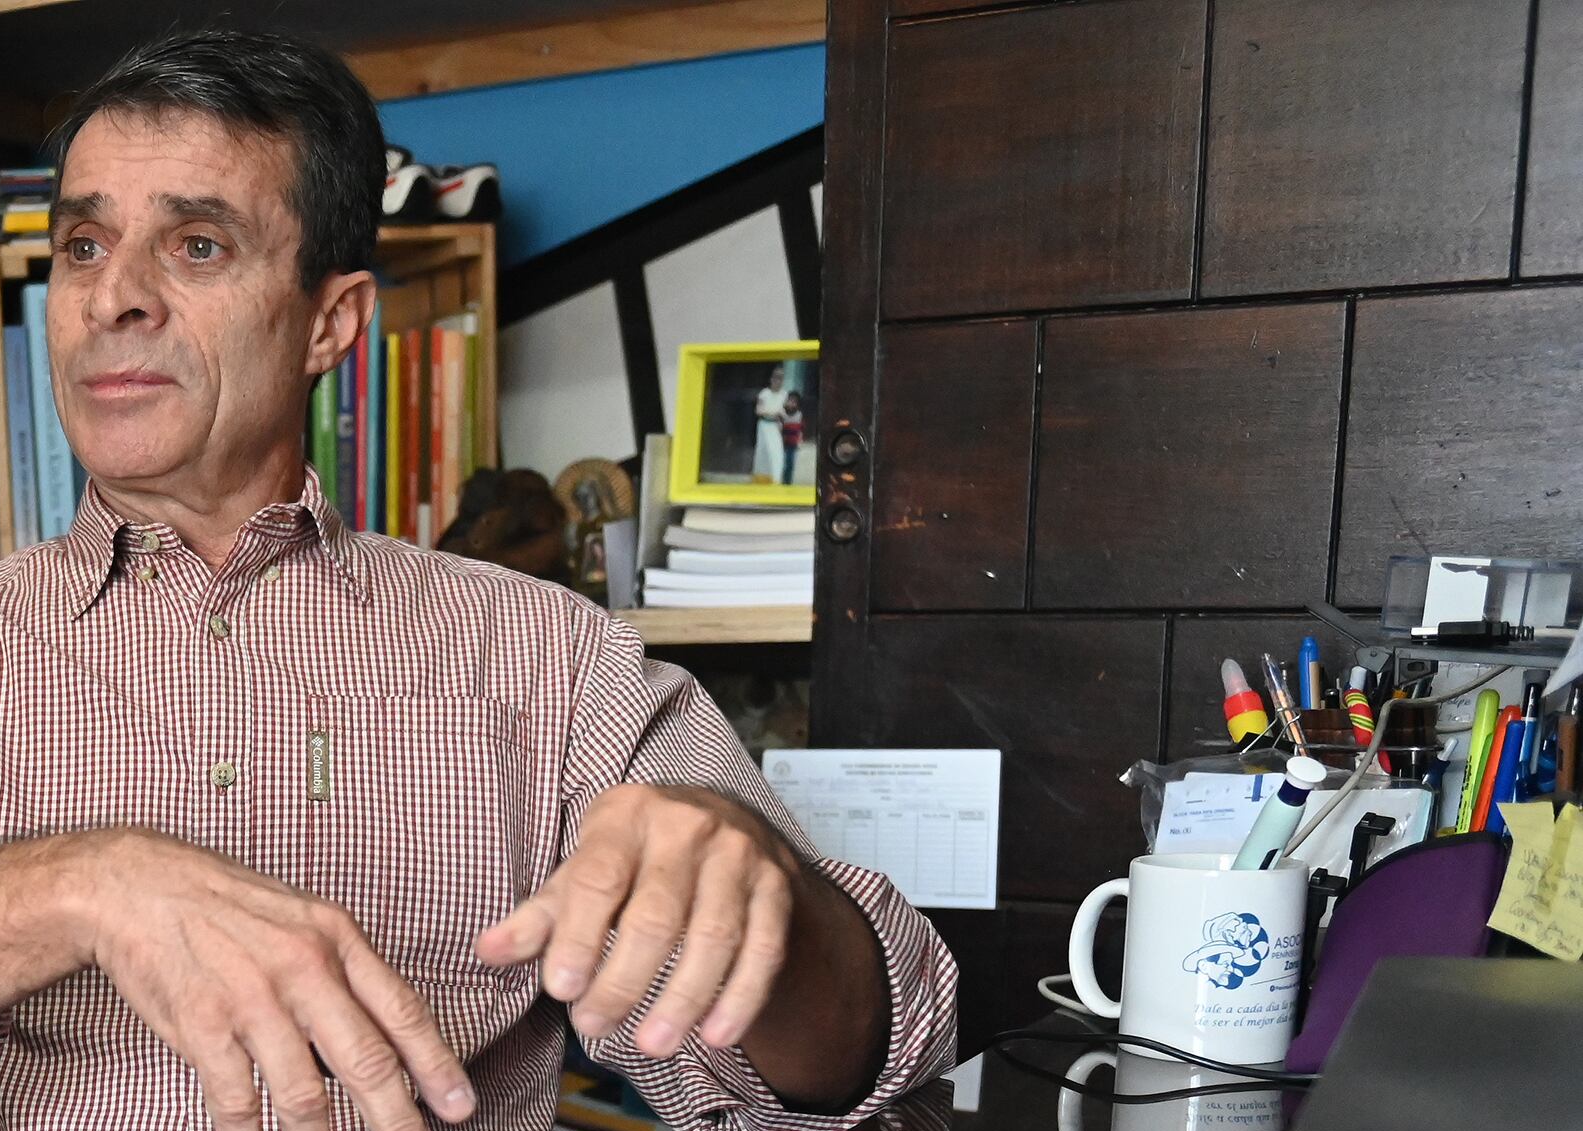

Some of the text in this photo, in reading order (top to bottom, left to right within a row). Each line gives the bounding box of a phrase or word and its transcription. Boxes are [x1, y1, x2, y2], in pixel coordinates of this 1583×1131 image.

[313, 748, 323, 794] Columbia
[1237, 1003, 1263, 1013] cada
[1213, 1017, 1274, 1029] ser el mejor
